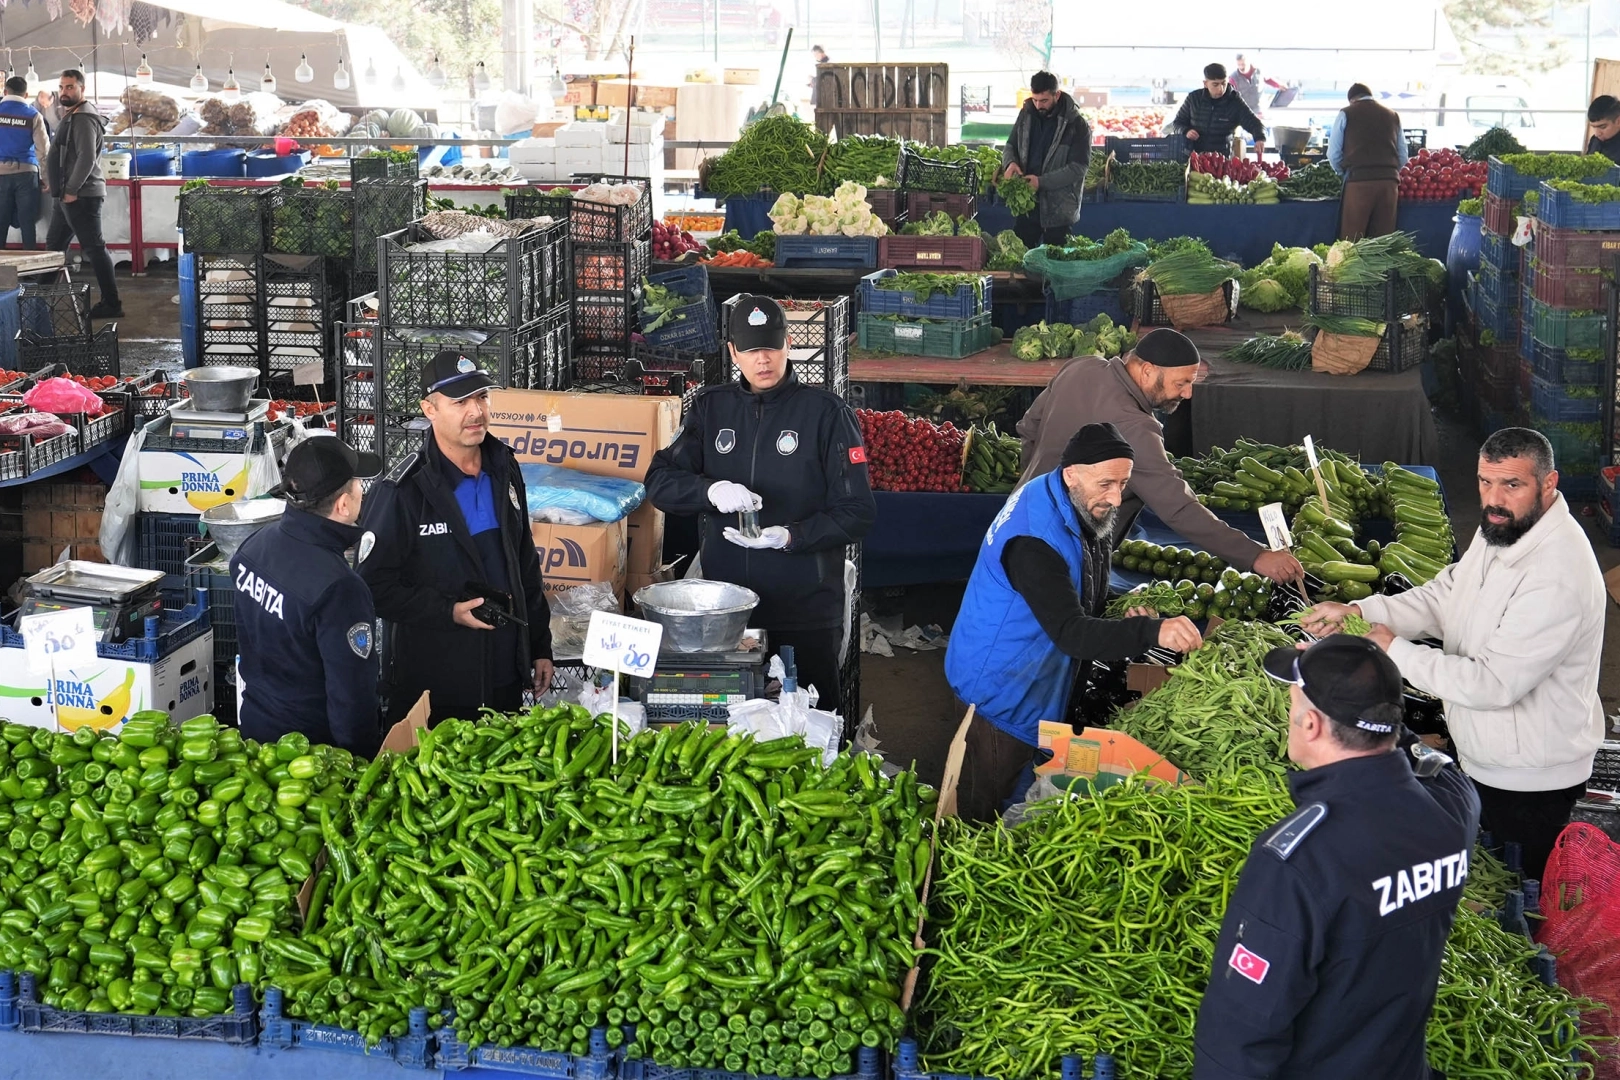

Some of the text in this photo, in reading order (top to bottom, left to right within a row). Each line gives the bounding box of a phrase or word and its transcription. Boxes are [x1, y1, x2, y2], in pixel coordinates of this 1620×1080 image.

[490, 412, 547, 422] By KÖKSAN
[513, 431, 640, 468] EuroCap
[181, 472, 219, 482] PRIMA
[181, 482, 221, 492] DONNA
[419, 522, 452, 536] ZABI
[236, 563, 284, 620] ZABITA
[180, 675, 199, 693] PRIMA
[179, 685, 200, 703] DONNA
[1356, 720, 1392, 733] ZABITA
[1372, 849, 1468, 917] ZABITA
